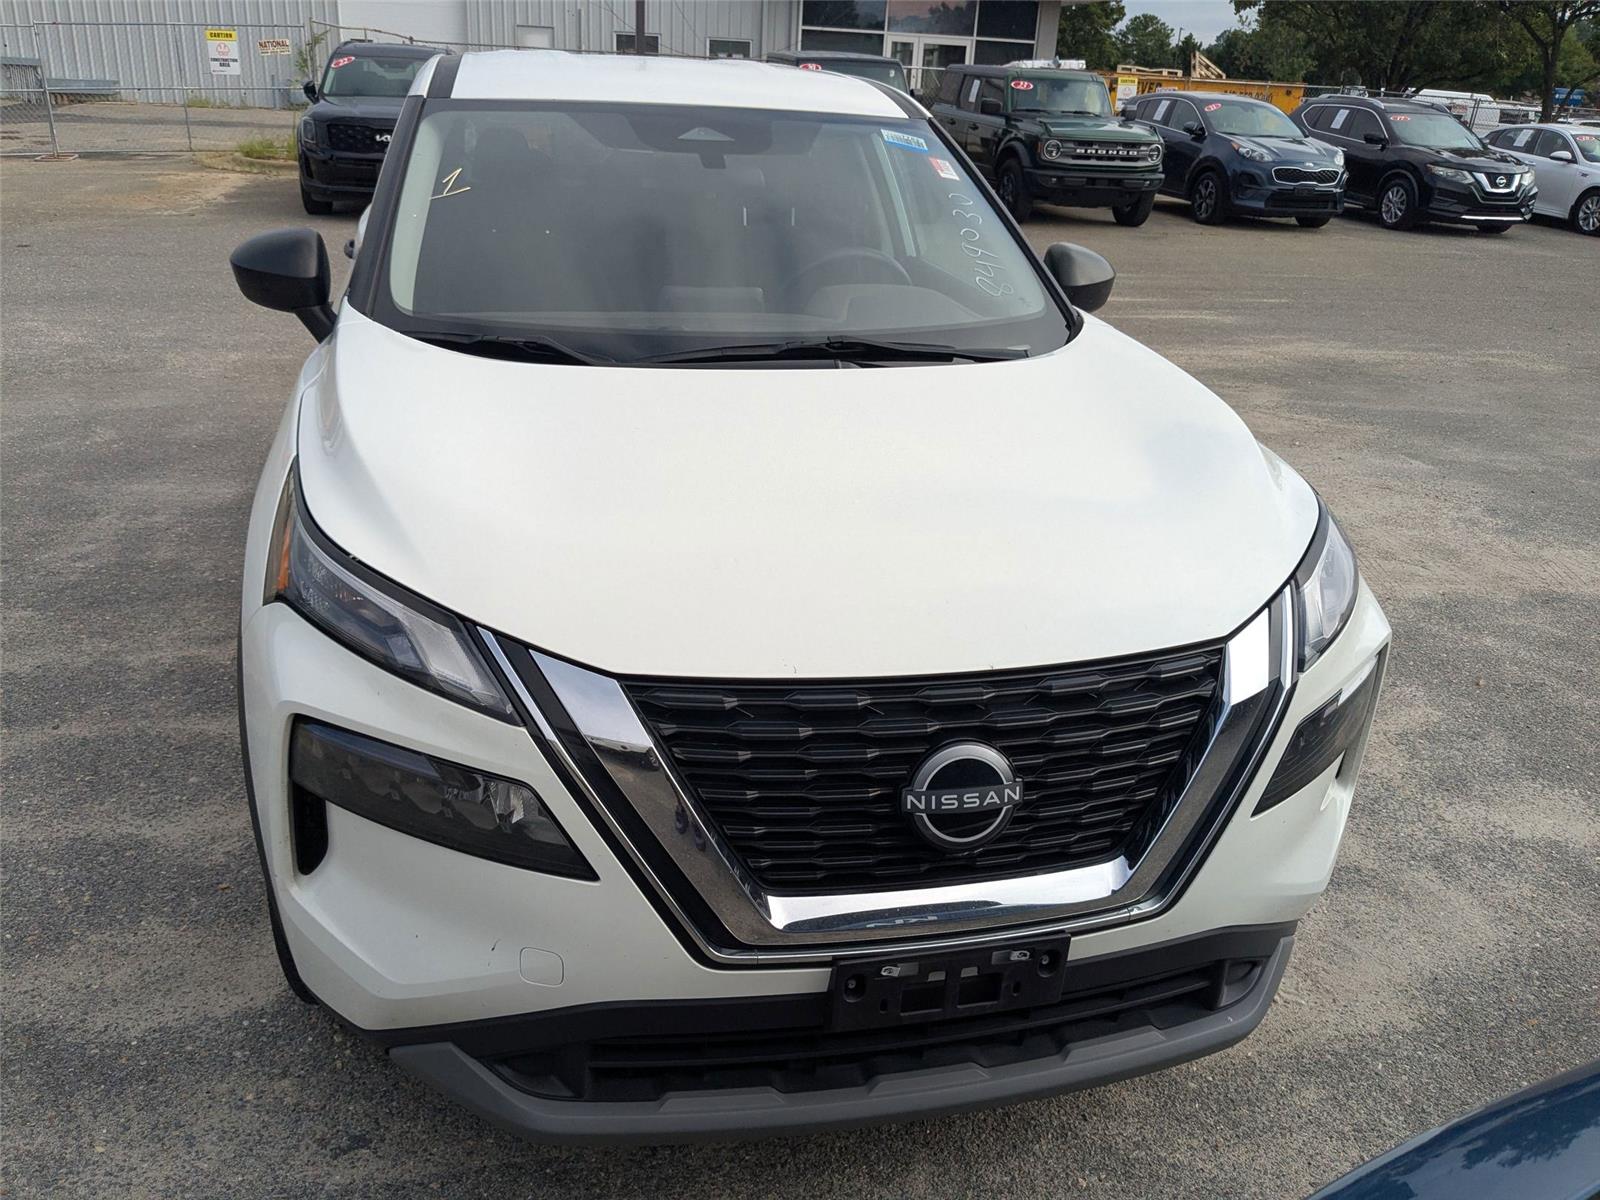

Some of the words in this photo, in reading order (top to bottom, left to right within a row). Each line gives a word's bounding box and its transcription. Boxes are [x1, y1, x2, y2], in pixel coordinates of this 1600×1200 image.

[258, 40, 289, 48] NATIONAL
[1075, 148, 1138, 156] BRONCO
[906, 786, 1020, 810] NISSAN
